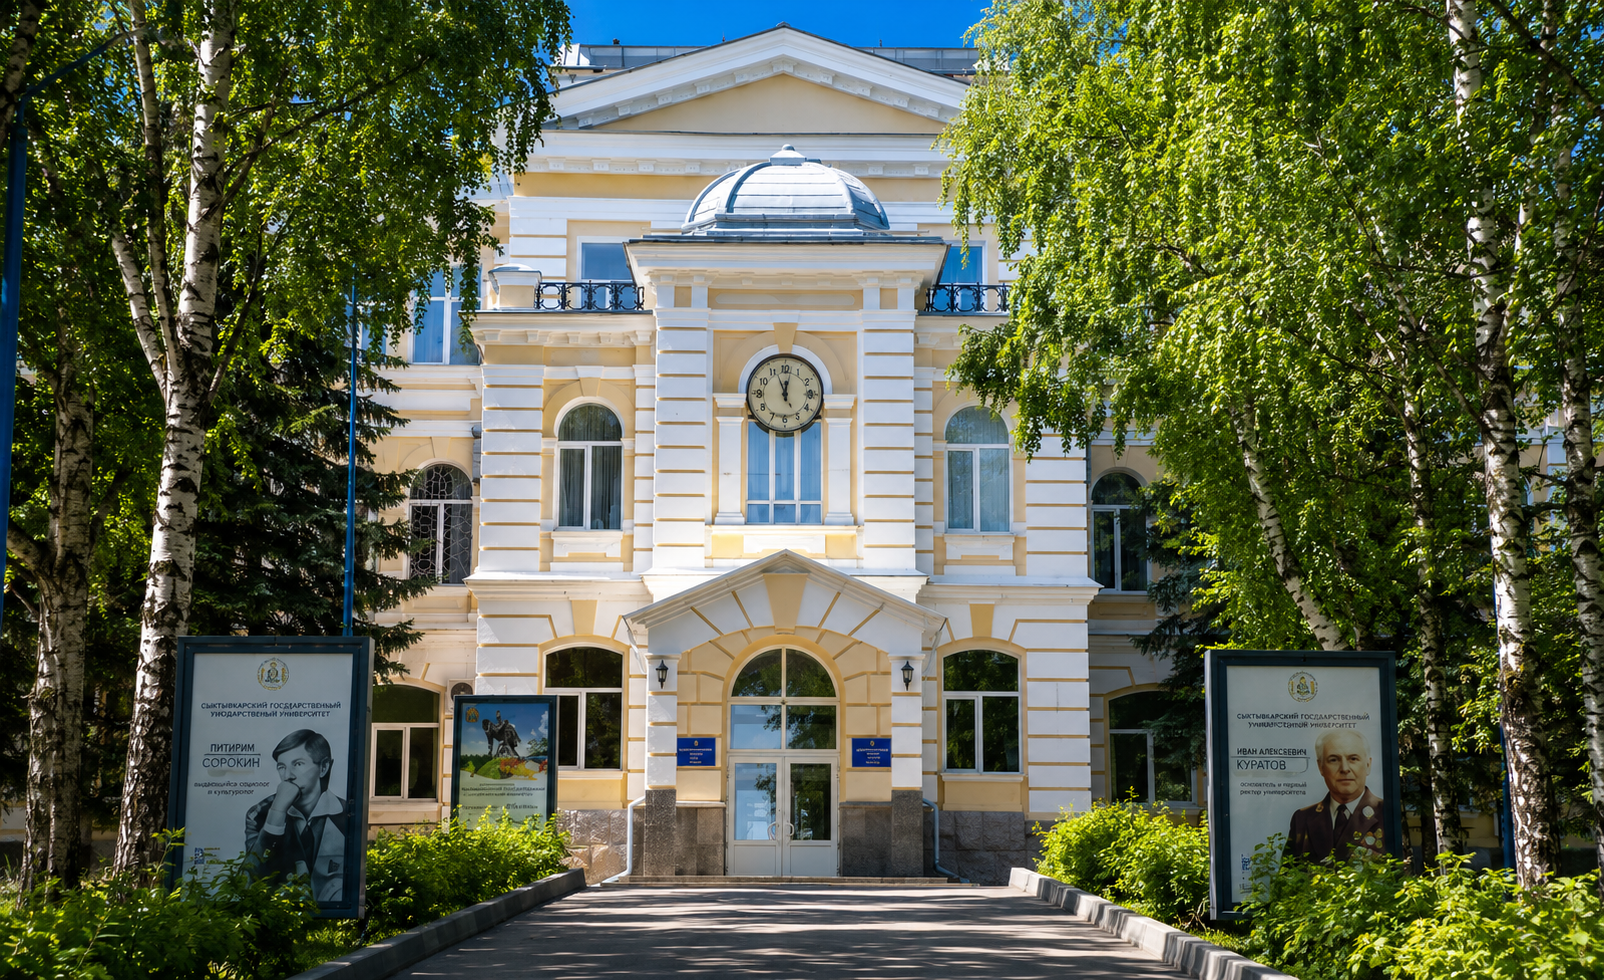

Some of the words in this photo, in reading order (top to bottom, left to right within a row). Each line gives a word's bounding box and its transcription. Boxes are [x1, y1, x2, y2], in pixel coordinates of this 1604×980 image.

[210, 743, 255, 752] ПИТИРИМ
[1236, 747, 1258, 755] ИВАН
[1259, 747, 1307, 755] АЛЕКСЕЕВИЧ
[202, 757, 260, 768] СОРОКИН
[1236, 759, 1287, 770] КУРАТОВ
